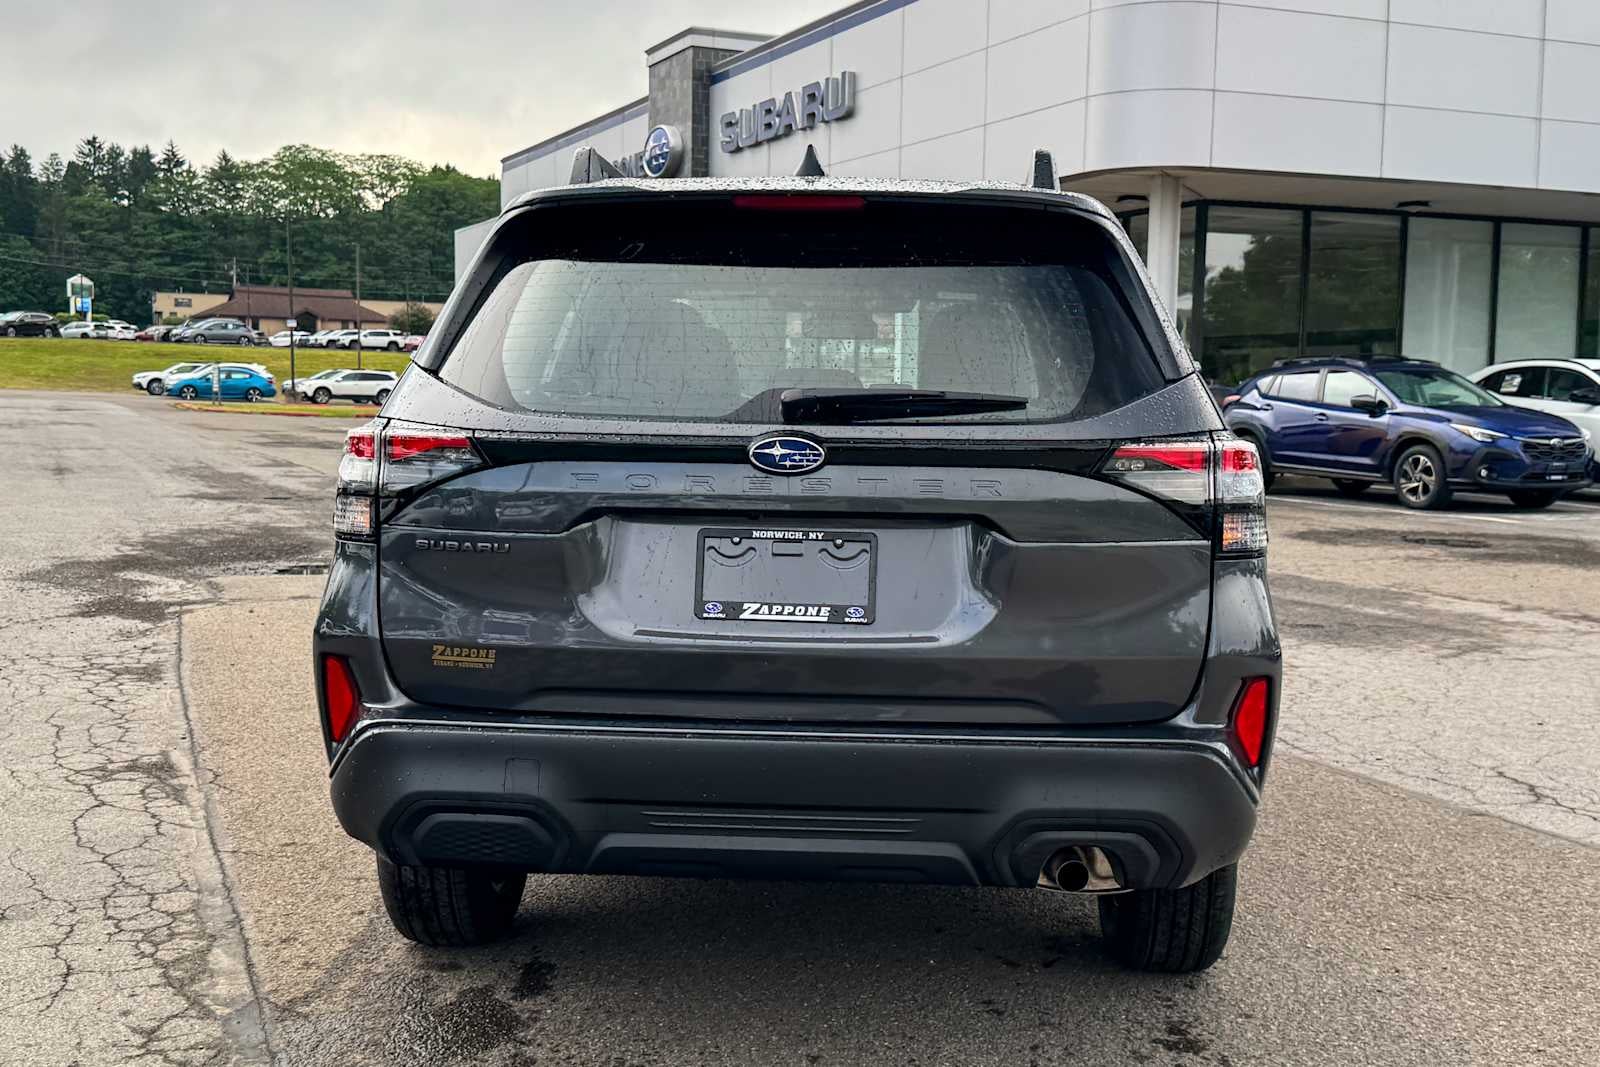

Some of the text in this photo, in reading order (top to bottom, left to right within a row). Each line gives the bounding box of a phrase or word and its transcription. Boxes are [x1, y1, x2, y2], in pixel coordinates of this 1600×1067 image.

[720, 71, 856, 154] SUBARU
[570, 472, 1003, 497] FORESTER
[415, 539, 511, 552] SUBARU
[808, 532, 825, 540] NY
[739, 602, 831, 622] ZAPPONE
[432, 644, 496, 663] ZAPPONE
